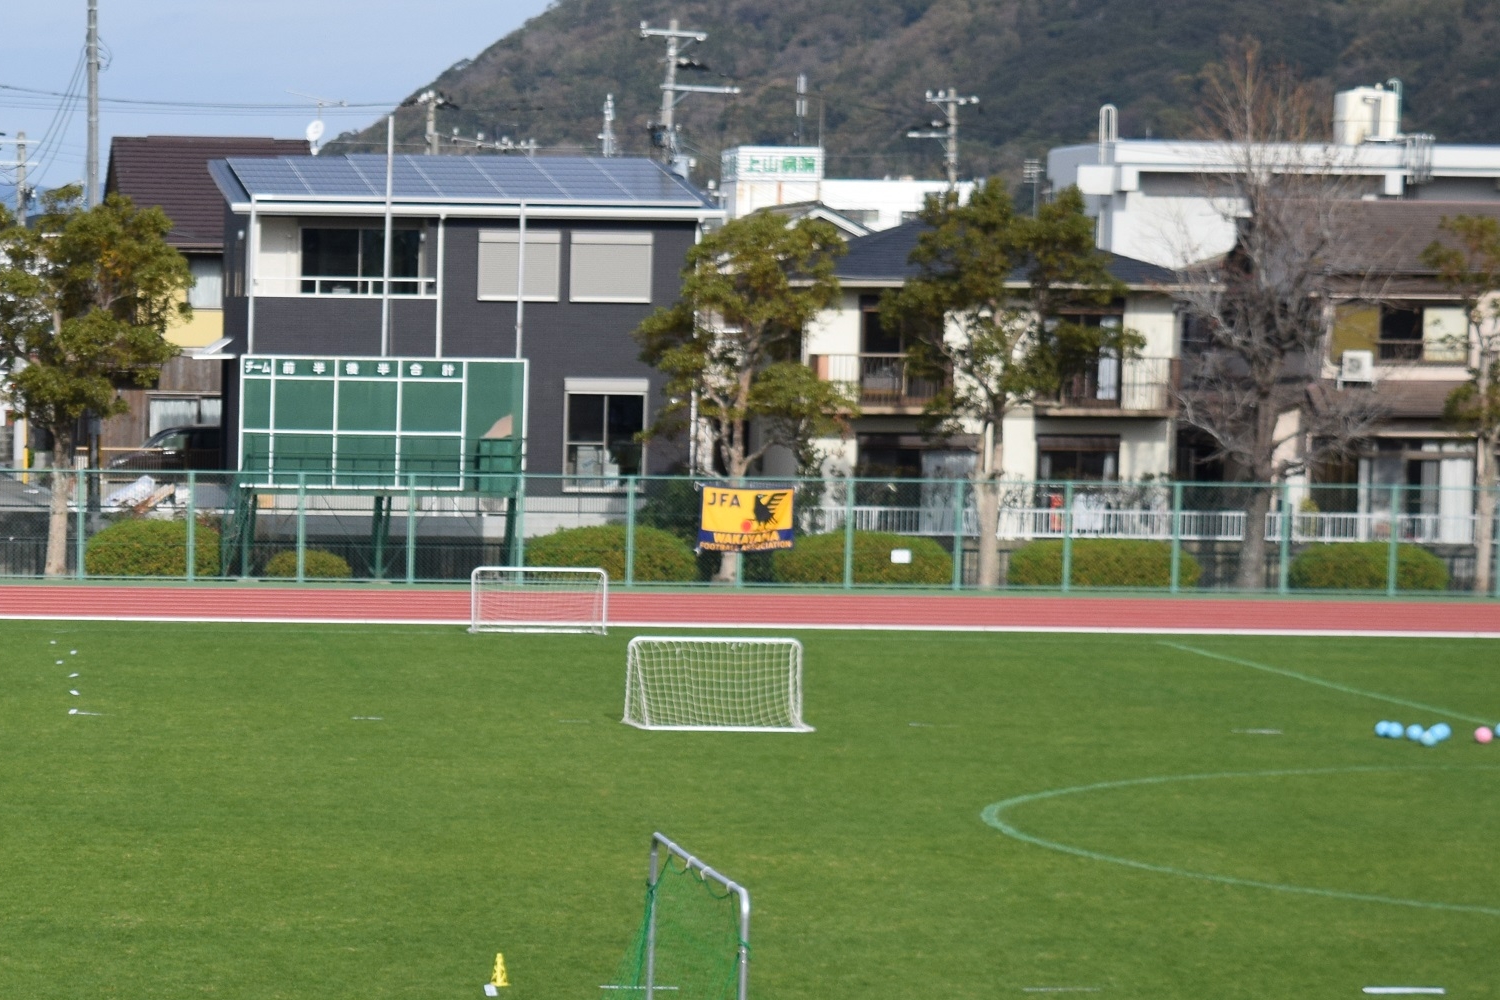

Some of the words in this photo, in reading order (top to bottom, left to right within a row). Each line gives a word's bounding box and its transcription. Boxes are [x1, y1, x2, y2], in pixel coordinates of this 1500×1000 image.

[244, 361, 271, 375] チーム
[282, 361, 326, 375] 前半
[345, 362, 391, 375] 後半
[409, 363, 455, 377] 合計
[708, 492, 740, 508] JFA
[714, 530, 780, 546] WAKAYAMA
[699, 541, 740, 553] FOOTBALL
